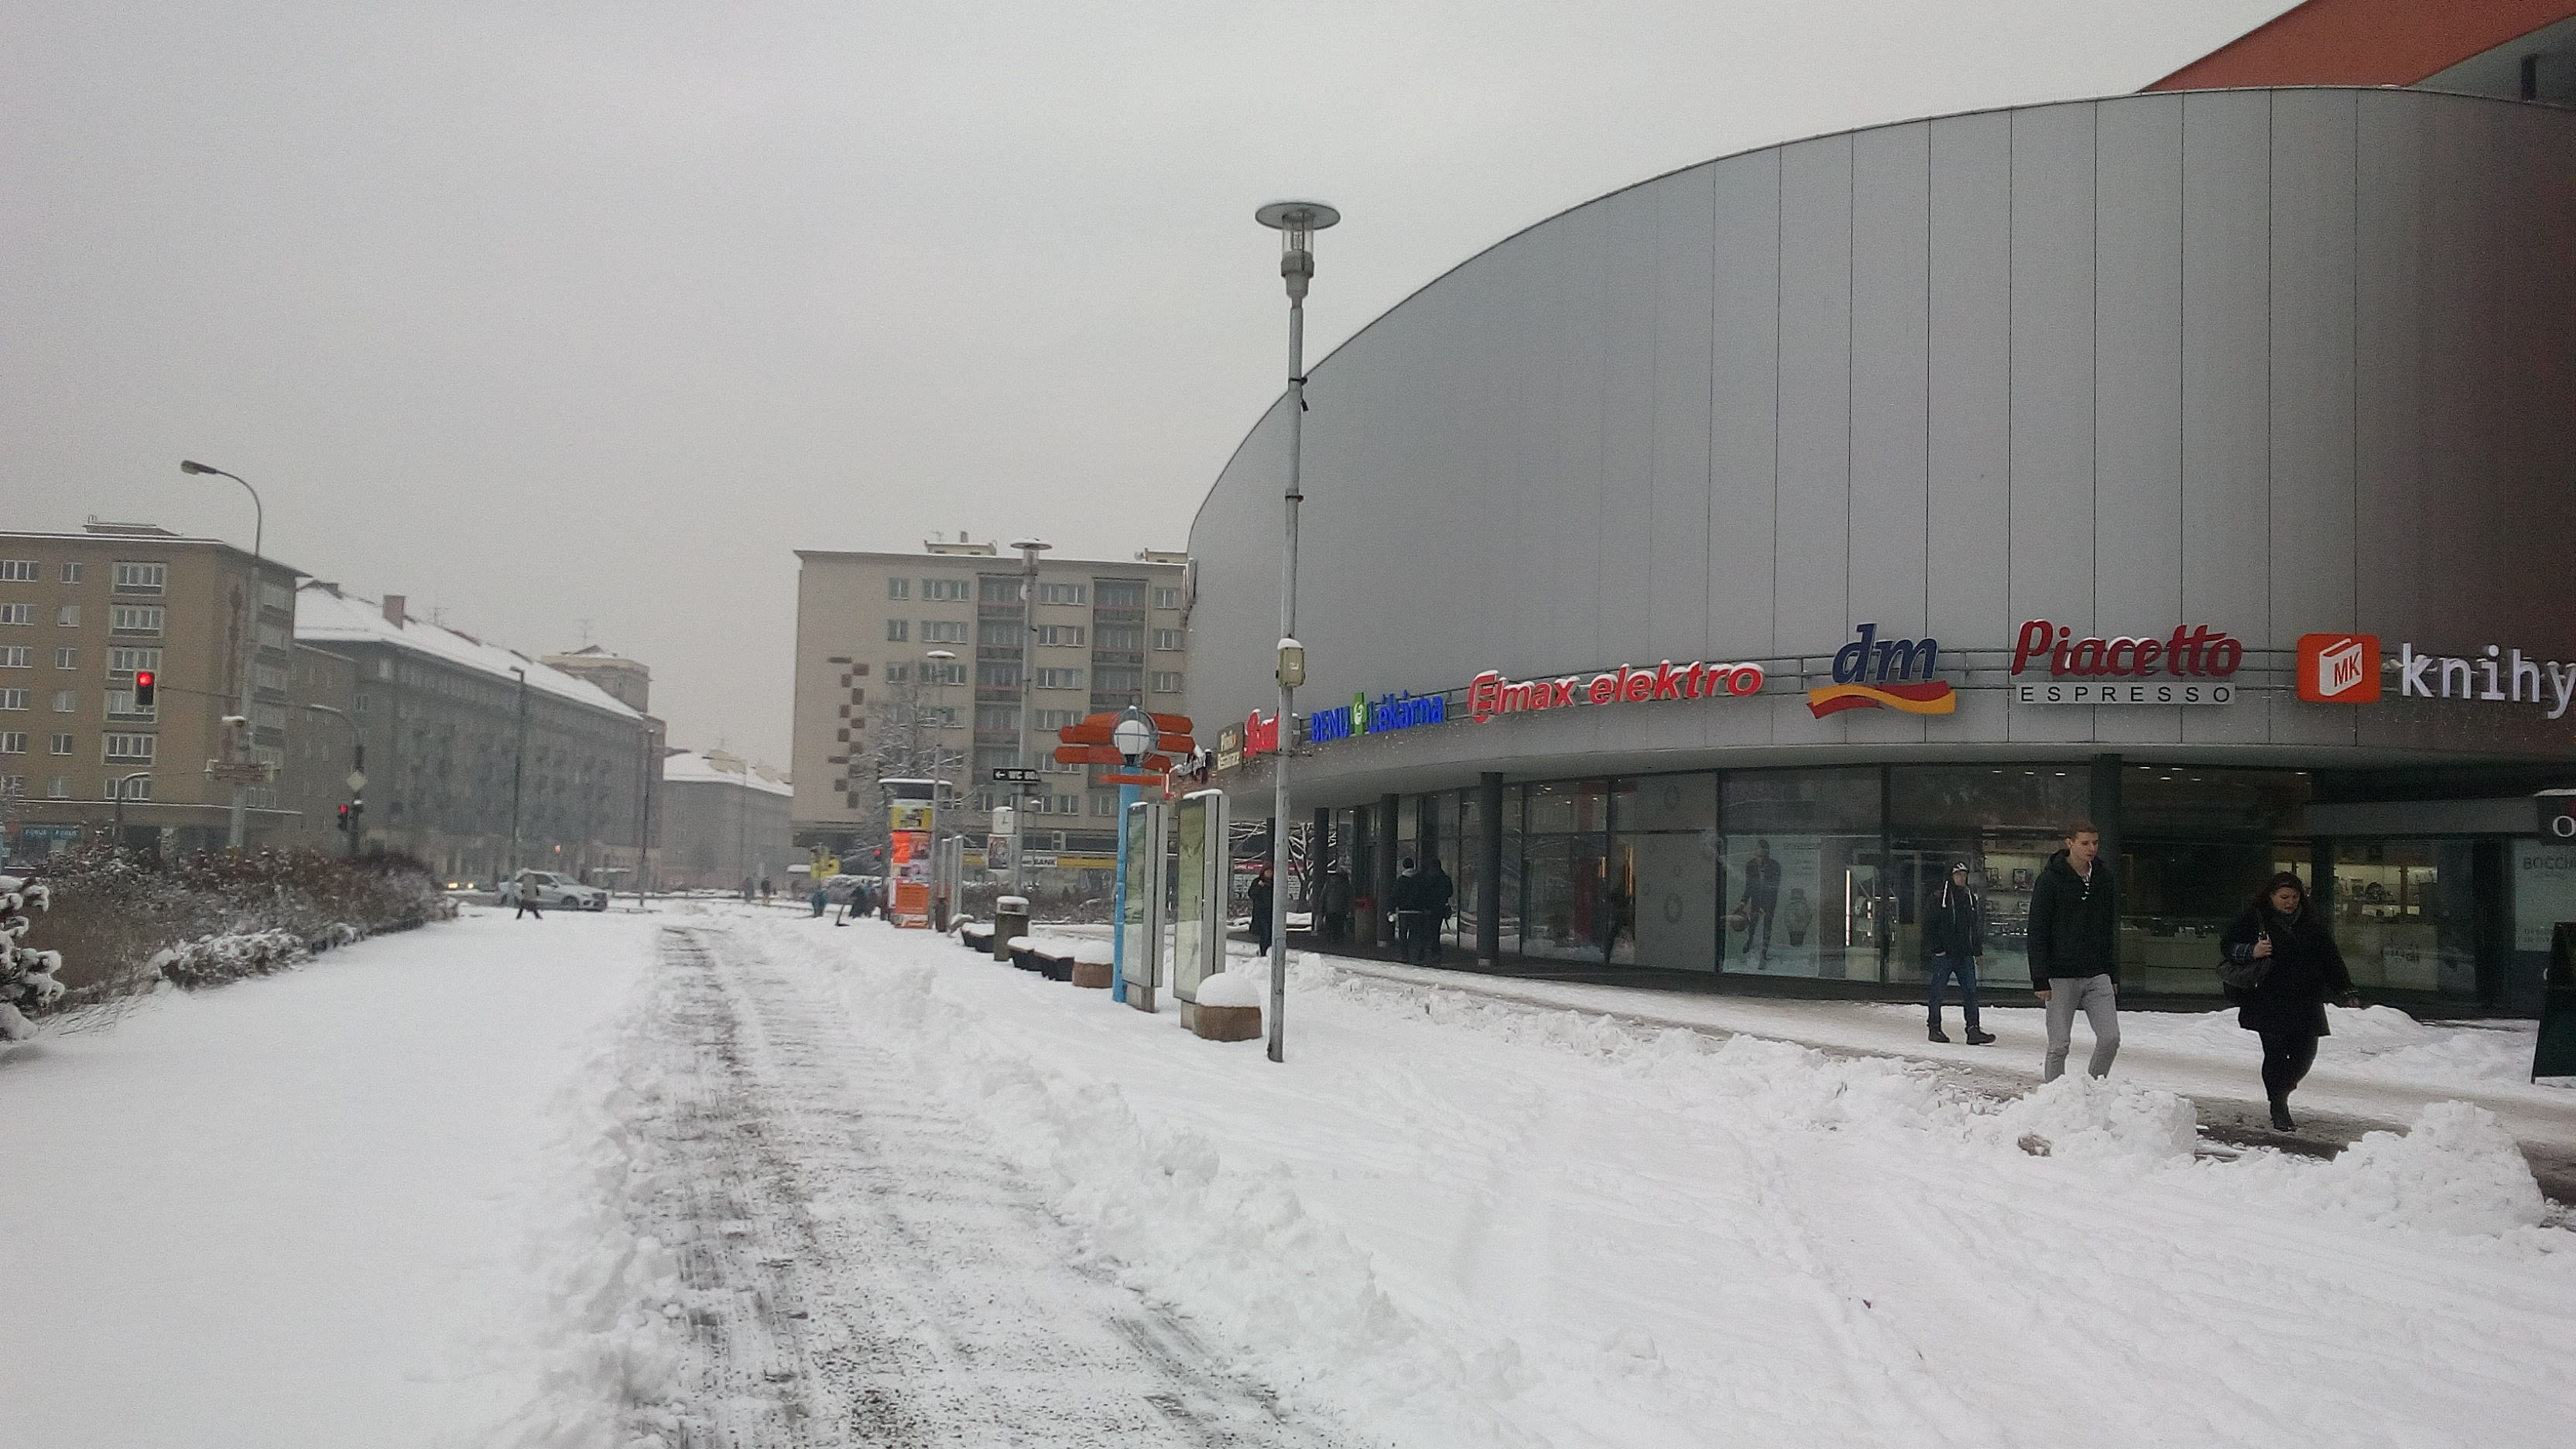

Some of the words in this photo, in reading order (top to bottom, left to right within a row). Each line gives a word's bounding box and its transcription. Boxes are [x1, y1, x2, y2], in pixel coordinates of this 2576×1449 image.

[1831, 622, 1939, 684] dm
[2011, 620, 2242, 677] Piacetto
[2334, 652, 2361, 687] MK
[1469, 670, 1578, 723] Elmax
[1588, 661, 1763, 705] elektro
[2021, 687, 2229, 702] ESPRESSO
[2403, 642, 2576, 719] knihy
[1310, 706, 1351, 743] BENU
